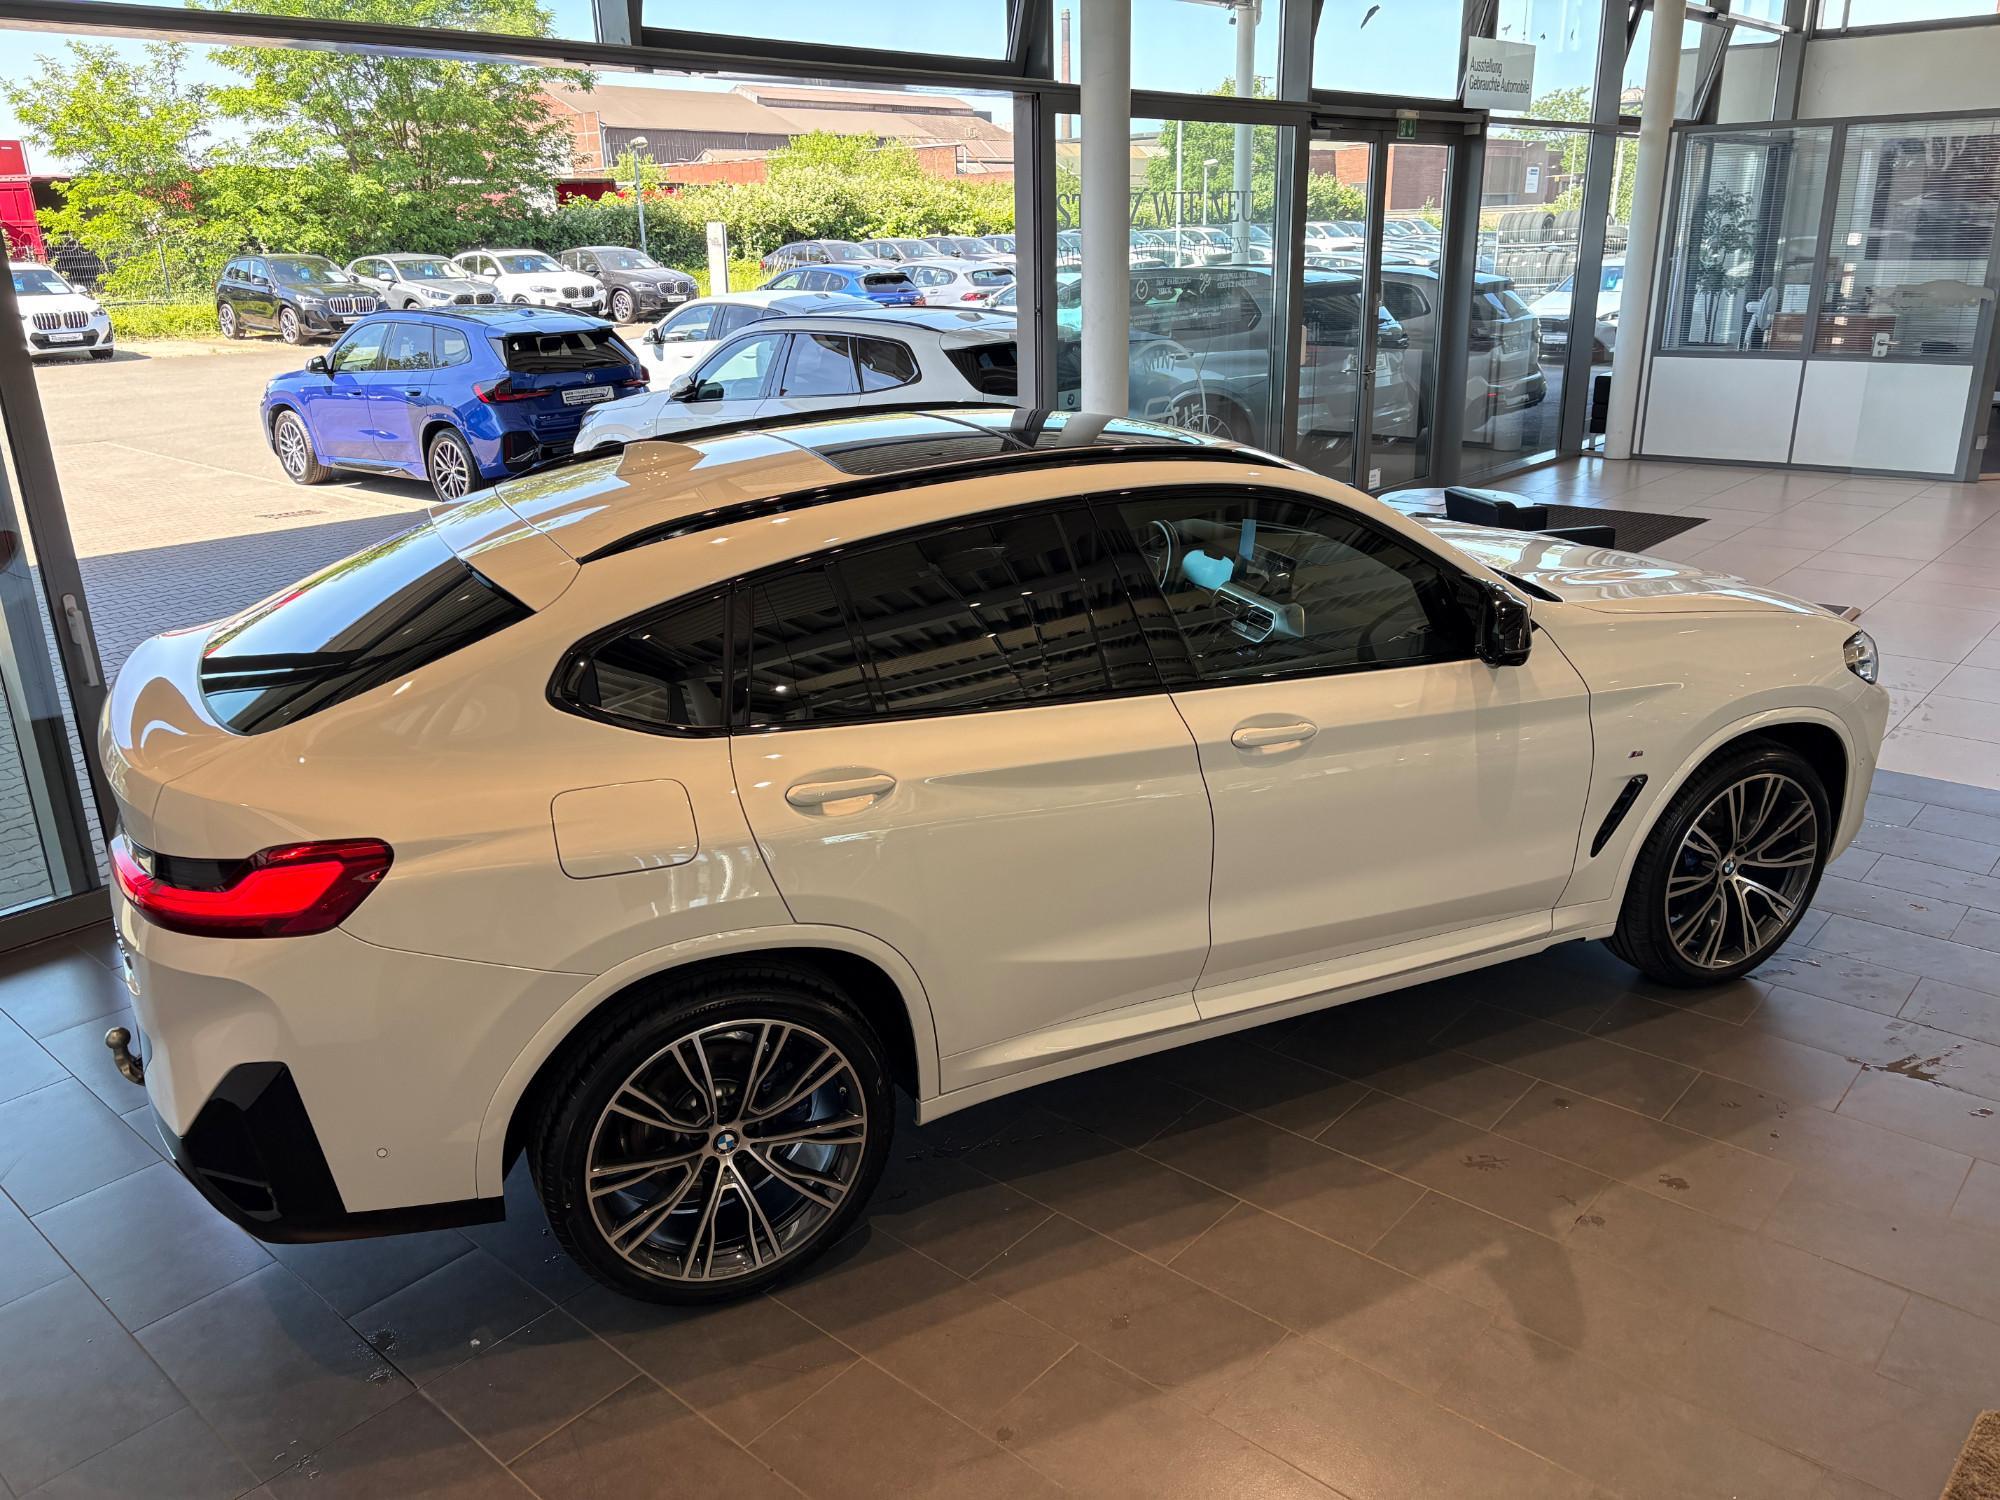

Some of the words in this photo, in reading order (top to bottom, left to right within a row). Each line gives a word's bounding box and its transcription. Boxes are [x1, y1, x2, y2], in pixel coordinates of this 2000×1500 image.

[1470, 56, 1503, 77] Ausstellung
[1469, 74, 1500, 91] Gebrauchte
[1501, 78, 1530, 94] Automobile
[1151, 191, 1202, 226] WIE
[1206, 190, 1255, 223] NEU
